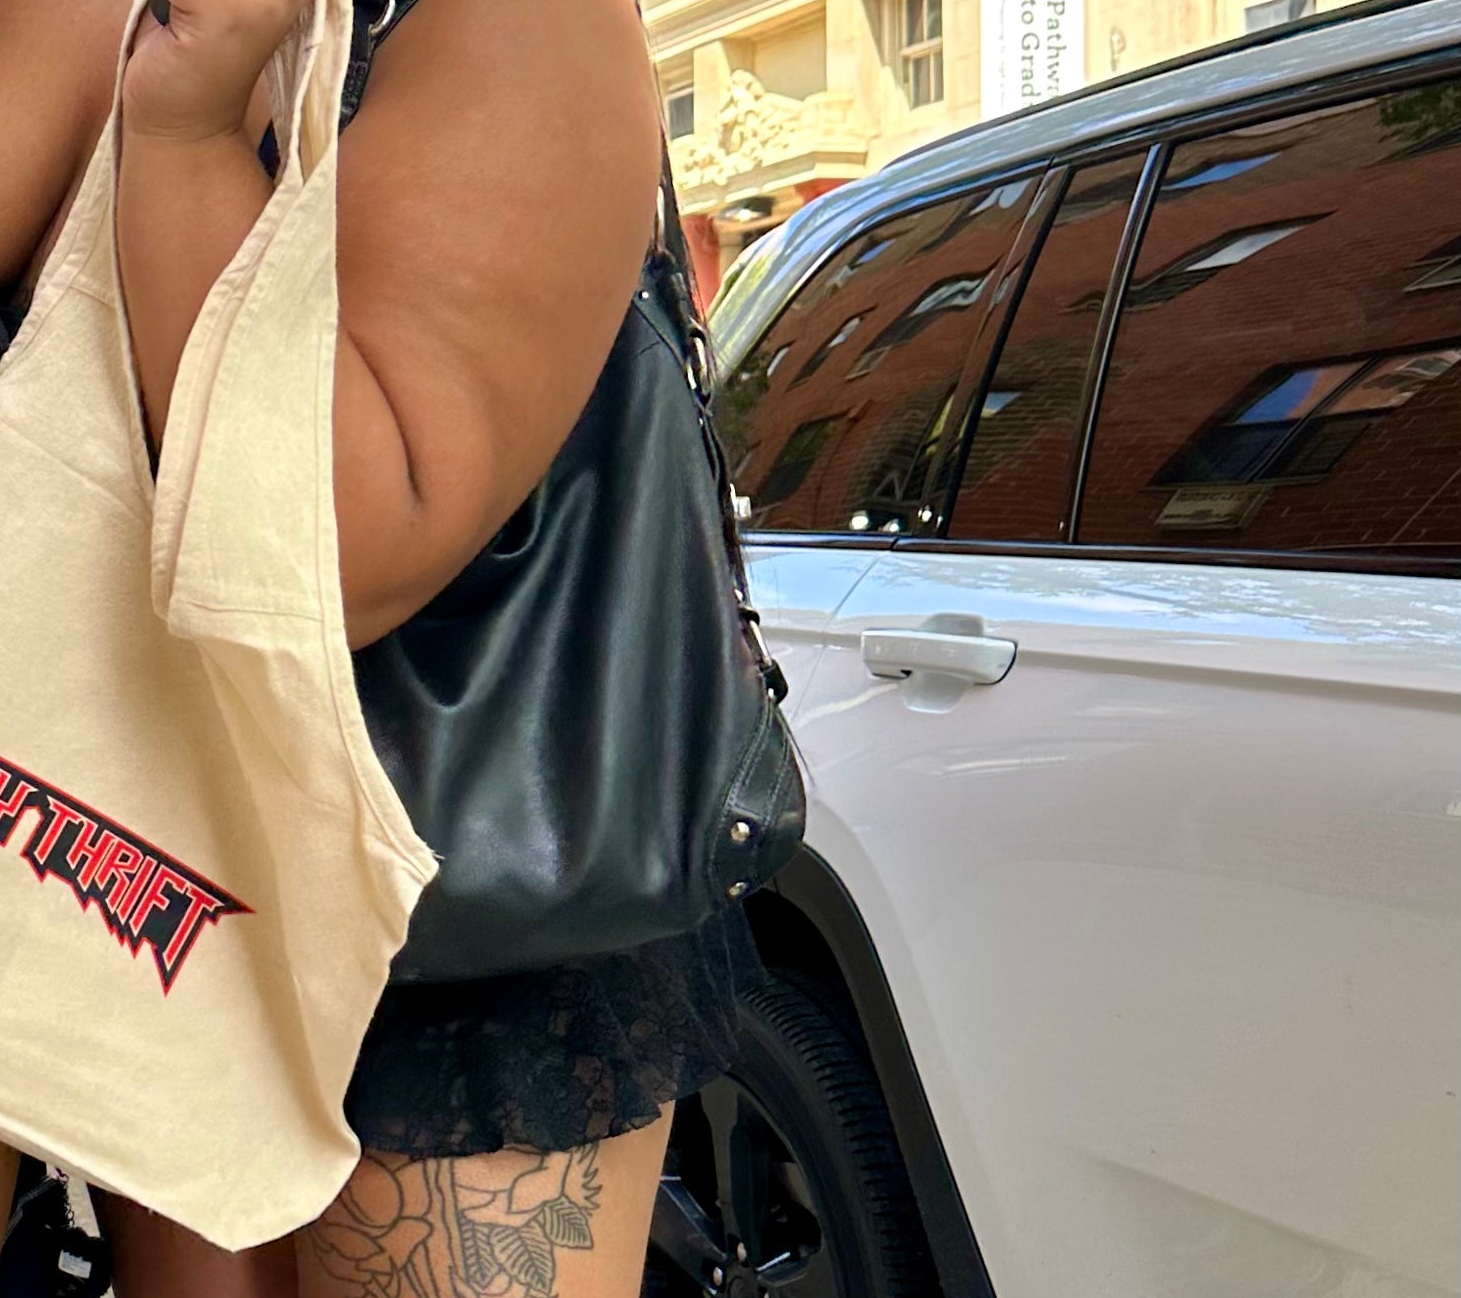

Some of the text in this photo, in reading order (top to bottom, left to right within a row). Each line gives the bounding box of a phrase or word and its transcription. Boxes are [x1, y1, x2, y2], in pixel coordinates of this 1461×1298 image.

[1021, 0, 1042, 106] to Grad
[34, 791, 228, 975] THRIFT
